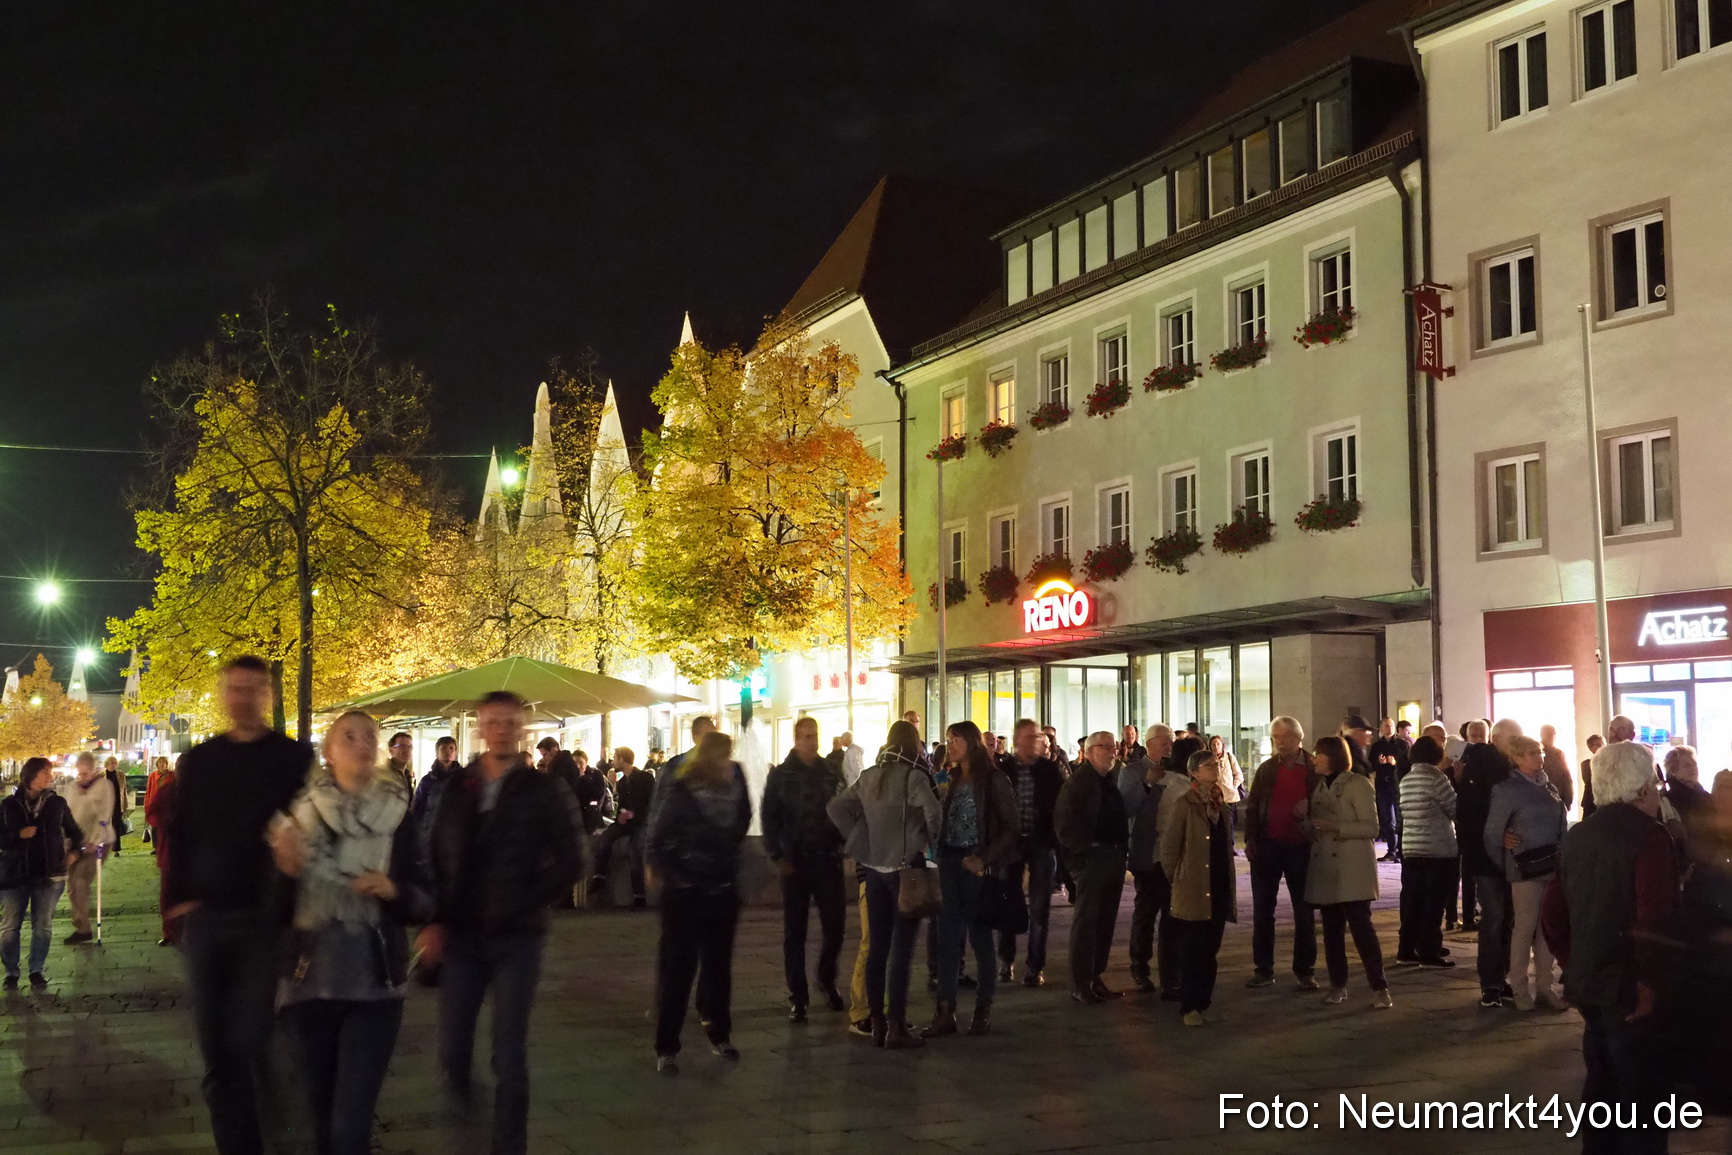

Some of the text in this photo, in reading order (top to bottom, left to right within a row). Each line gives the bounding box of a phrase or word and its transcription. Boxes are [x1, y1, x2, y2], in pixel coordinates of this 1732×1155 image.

[1421, 303, 1438, 367] Achatz
[1023, 590, 1089, 632] RENO
[1638, 607, 1728, 646] Achatz
